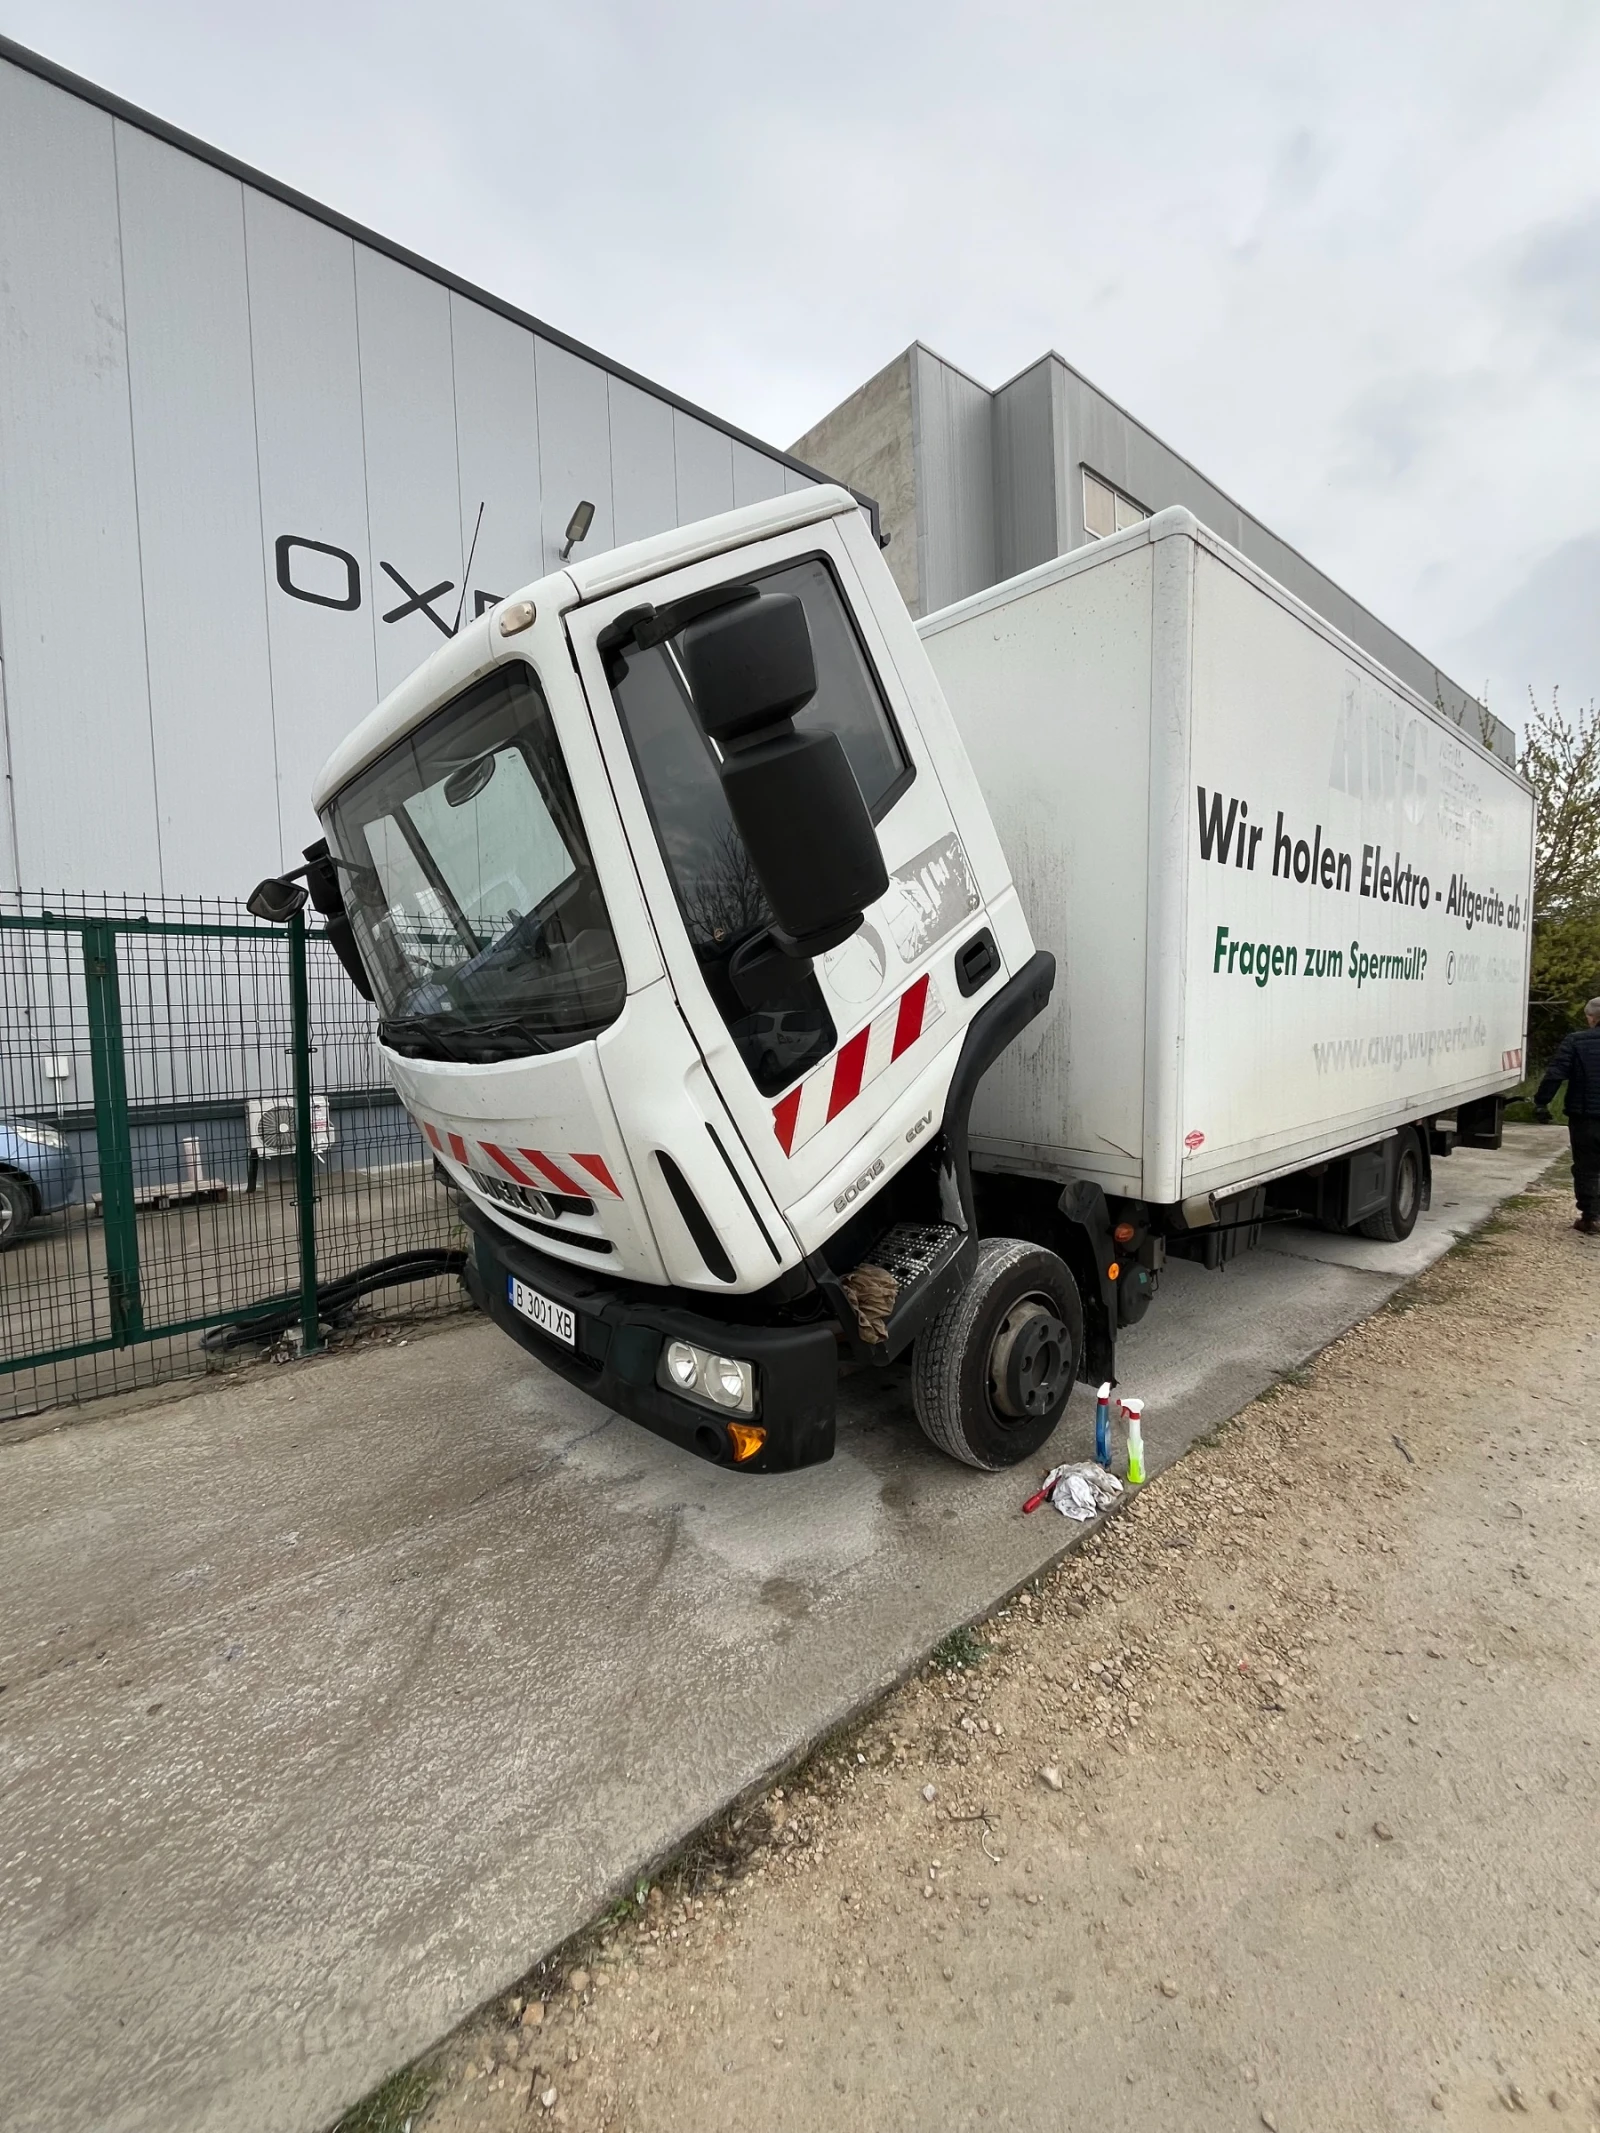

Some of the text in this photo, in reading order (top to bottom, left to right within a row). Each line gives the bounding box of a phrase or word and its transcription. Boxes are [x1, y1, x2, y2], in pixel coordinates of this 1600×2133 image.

[275, 534, 507, 639] OX
[1197, 785, 1263, 871] Wir
[1272, 811, 1352, 893] holen
[1360, 844, 1430, 910] Elektro
[1446, 874, 1504, 931] Altgeräte
[1213, 926, 1298, 988] Fragen
[1303, 948, 1343, 978] zum
[1348, 941, 1427, 989] Sperrmüll?
[833, 1109, 933, 1214] 80E18 EEV
[516, 1284, 523, 1308] B
[556, 1308, 573, 1339] XB
